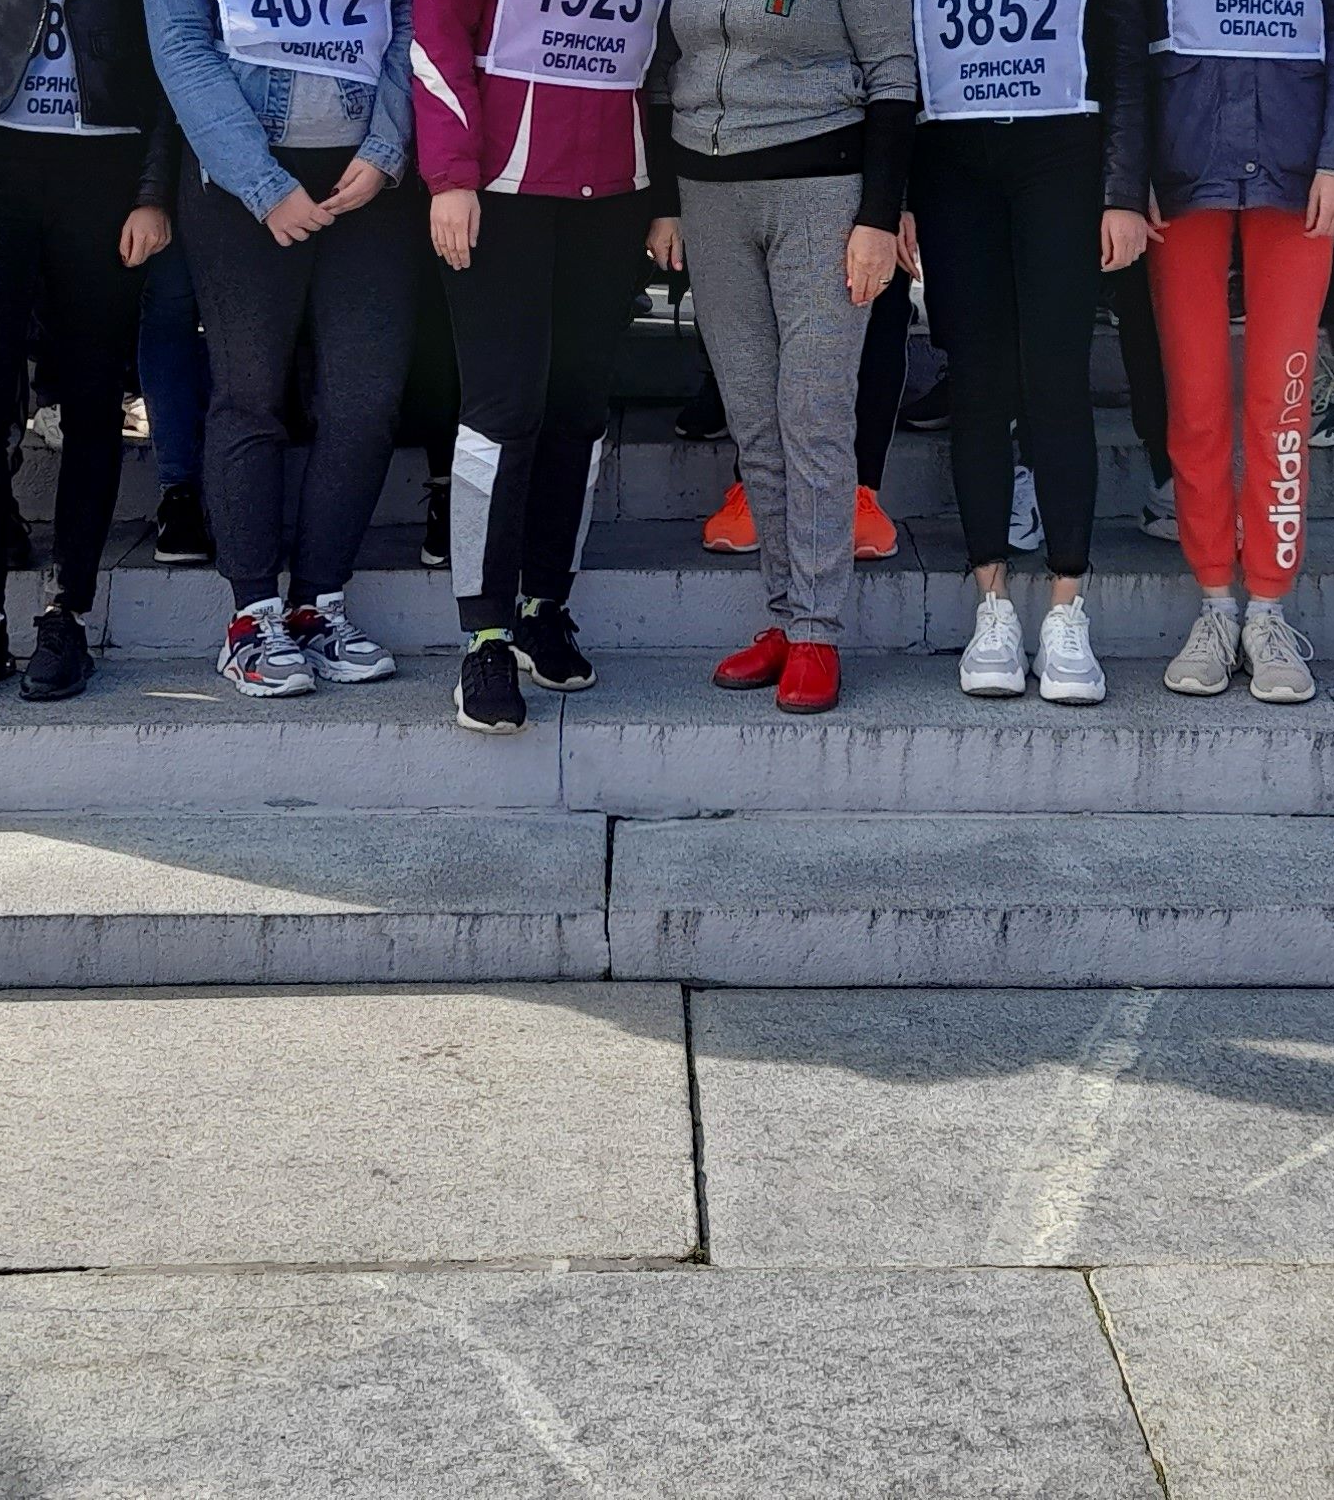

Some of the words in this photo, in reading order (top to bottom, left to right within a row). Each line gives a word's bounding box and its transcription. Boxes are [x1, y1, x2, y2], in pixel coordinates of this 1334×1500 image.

[1220, 19, 1297, 38] ОБЛАСТЬ
[541, 29, 625, 54] БРЯНСКАЯ
[542, 52, 617, 74] ОБЛАСТЬ
[960, 58, 1045, 80] БРЯНСКАЯ
[963, 81, 1041, 101] ОБЛАСТЬ
[1279, 351, 1309, 425] neo
[1268, 428, 1301, 570] adidas
